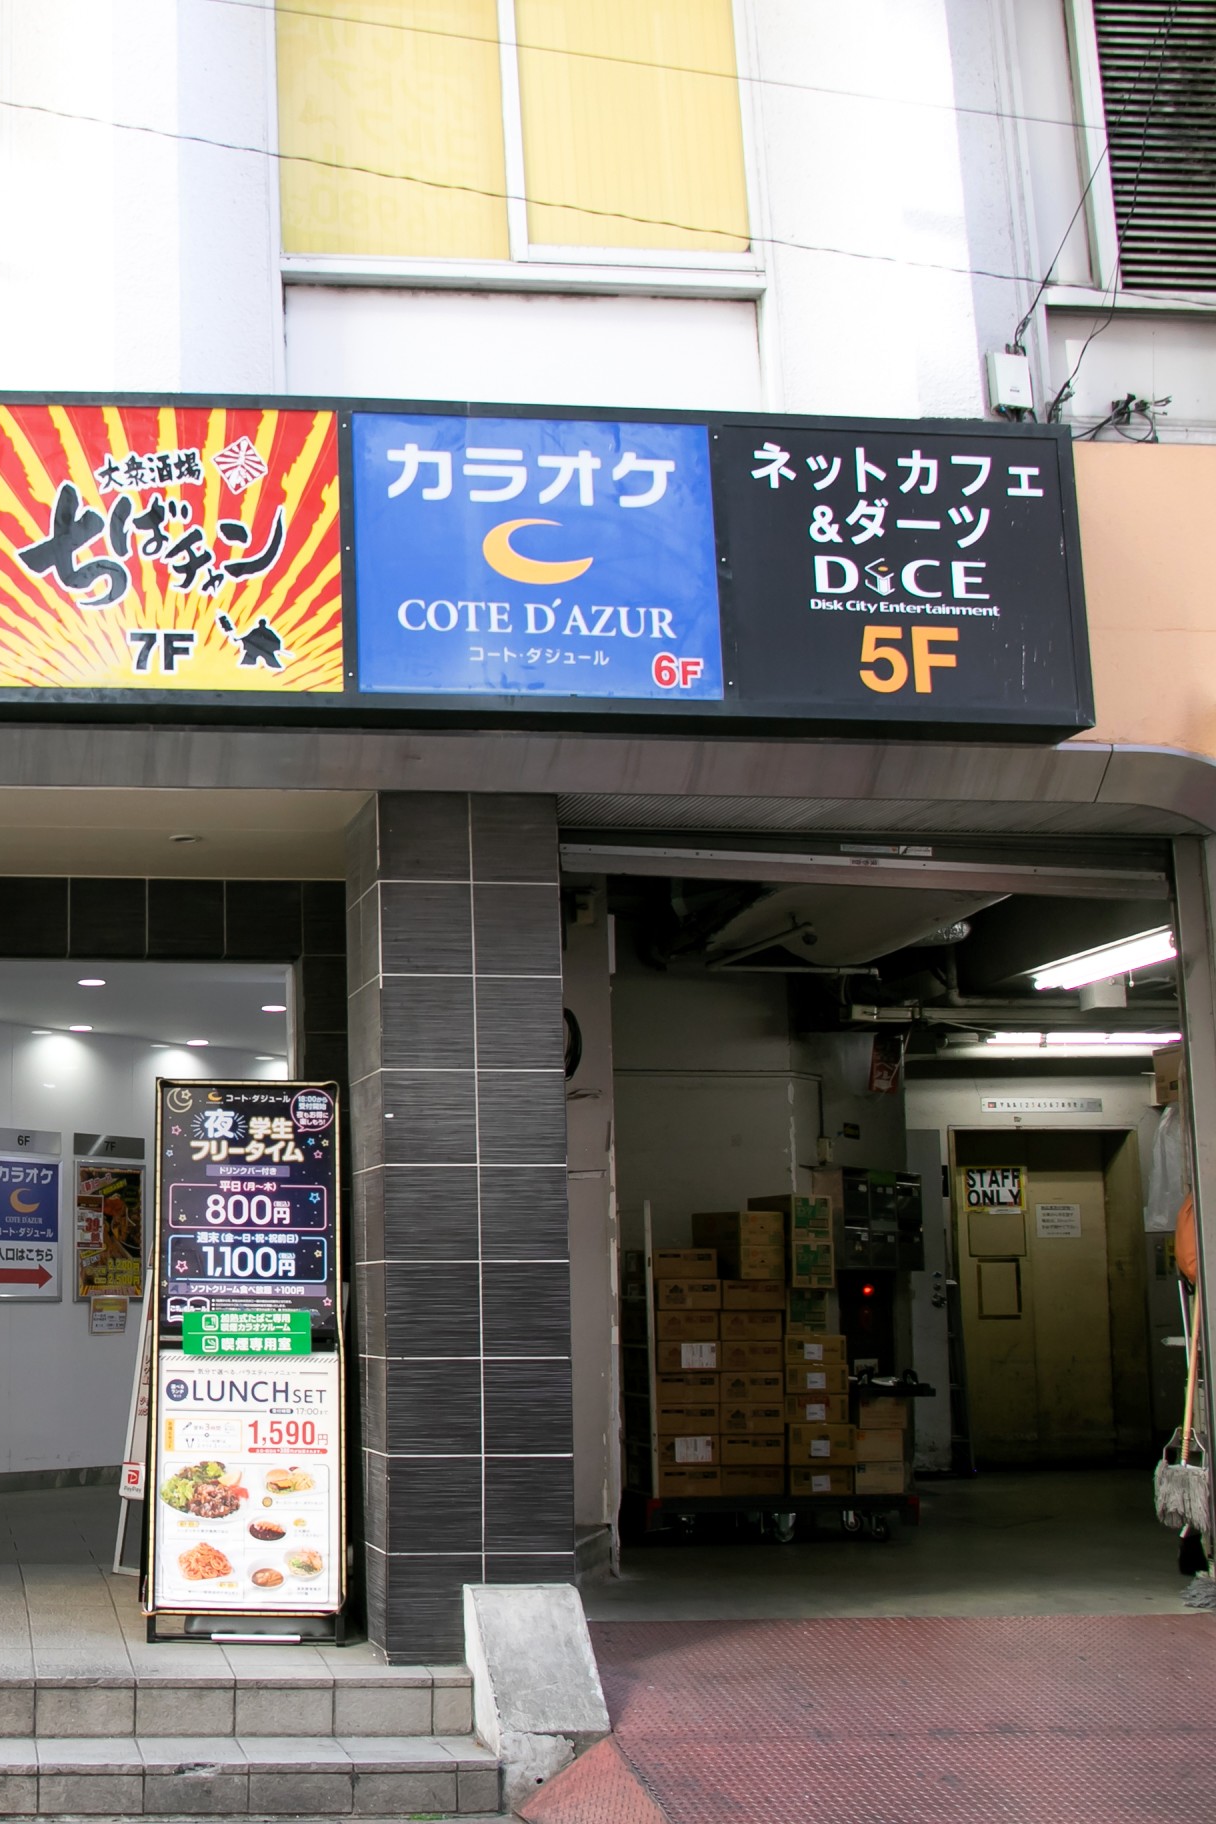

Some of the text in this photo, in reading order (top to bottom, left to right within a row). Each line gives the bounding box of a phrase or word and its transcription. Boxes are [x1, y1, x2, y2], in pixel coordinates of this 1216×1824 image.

[99, 451, 202, 489] 大衆酒場
[387, 443, 676, 508] カラオケ
[751, 441, 1044, 497] ネットカフェ
[809, 498, 991, 548] &ダーツ
[397, 599, 513, 633] COTE
[810, 599, 1001, 617] Disk City Entertainment
[129, 632, 195, 671] 7F
[859, 625, 959, 693] 5F
[653, 653, 703, 688] 6F
[204, 1108, 294, 1140] 夜 学生
[17, 1134, 31, 1146] 6F
[104, 1141, 116, 1152] 7F
[190, 1140, 304, 1162] フリータイム
[219, 1166, 277, 1176] ドリンクバー付き
[966, 1167, 1021, 1188] STAFF
[967, 1189, 1021, 1206] ONLY
[221, 1337, 292, 1351] 喫煙専用室
[193, 1379, 327, 1403] LUNCH SET
